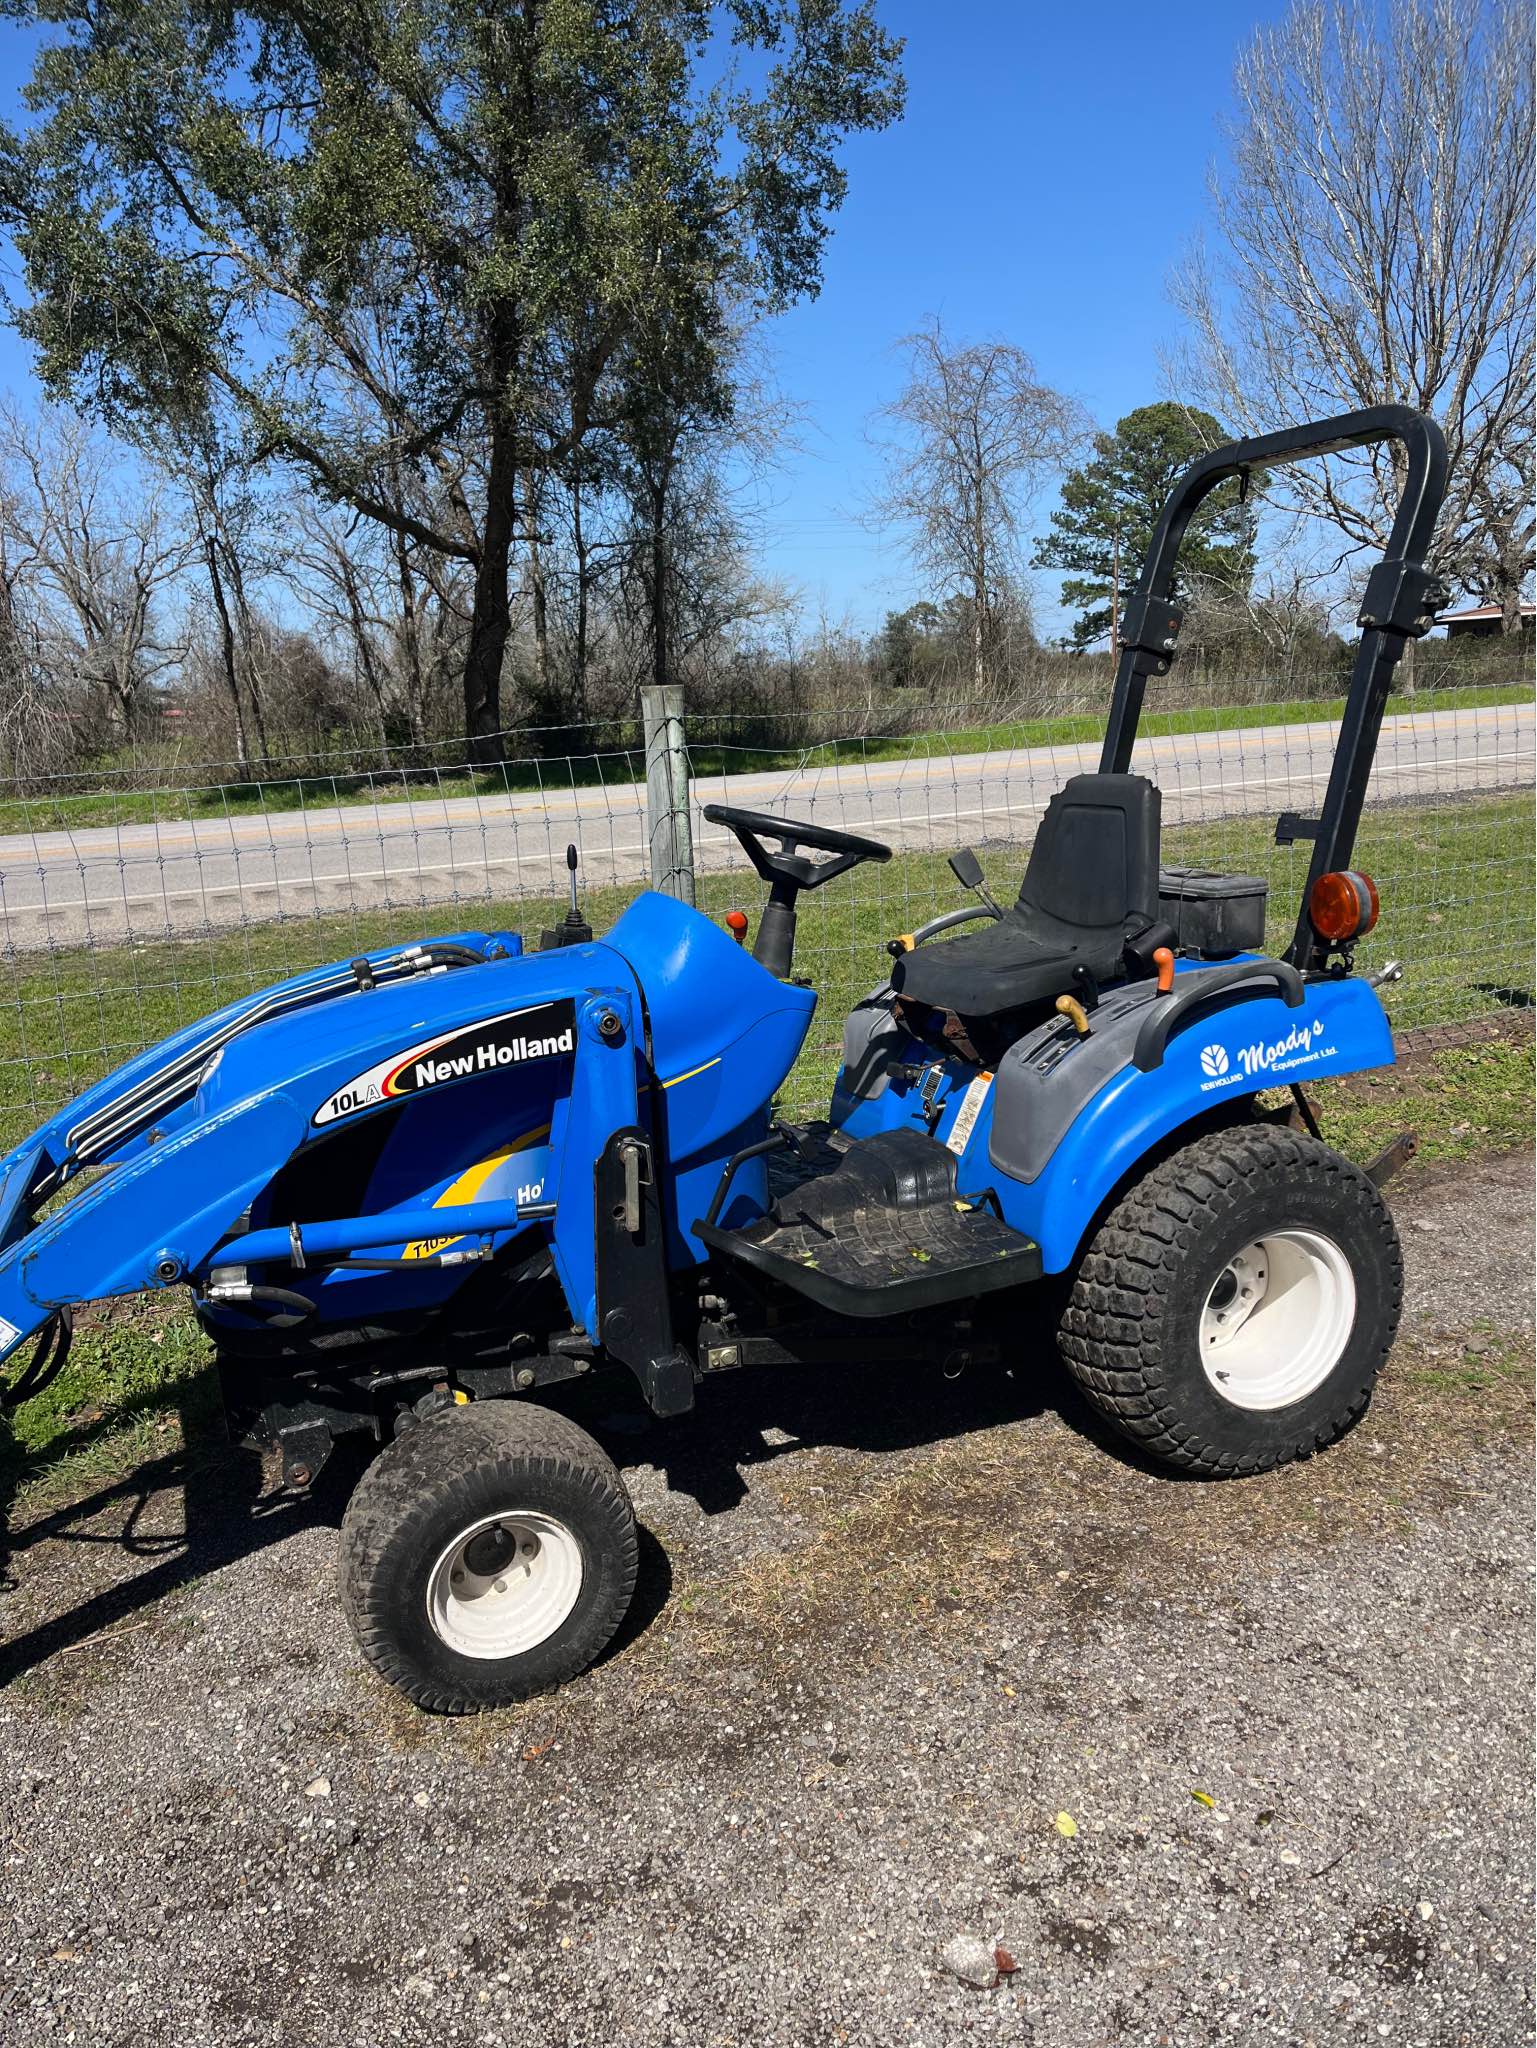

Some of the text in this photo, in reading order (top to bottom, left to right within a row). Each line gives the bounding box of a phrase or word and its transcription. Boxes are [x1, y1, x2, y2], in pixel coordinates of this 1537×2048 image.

[415, 1029, 574, 1088] New Holland
[1271, 1052, 1320, 1072] Equipment
[1200, 1073, 1244, 1092] NEW HOLLAND
[330, 1083, 381, 1115] 10LA
